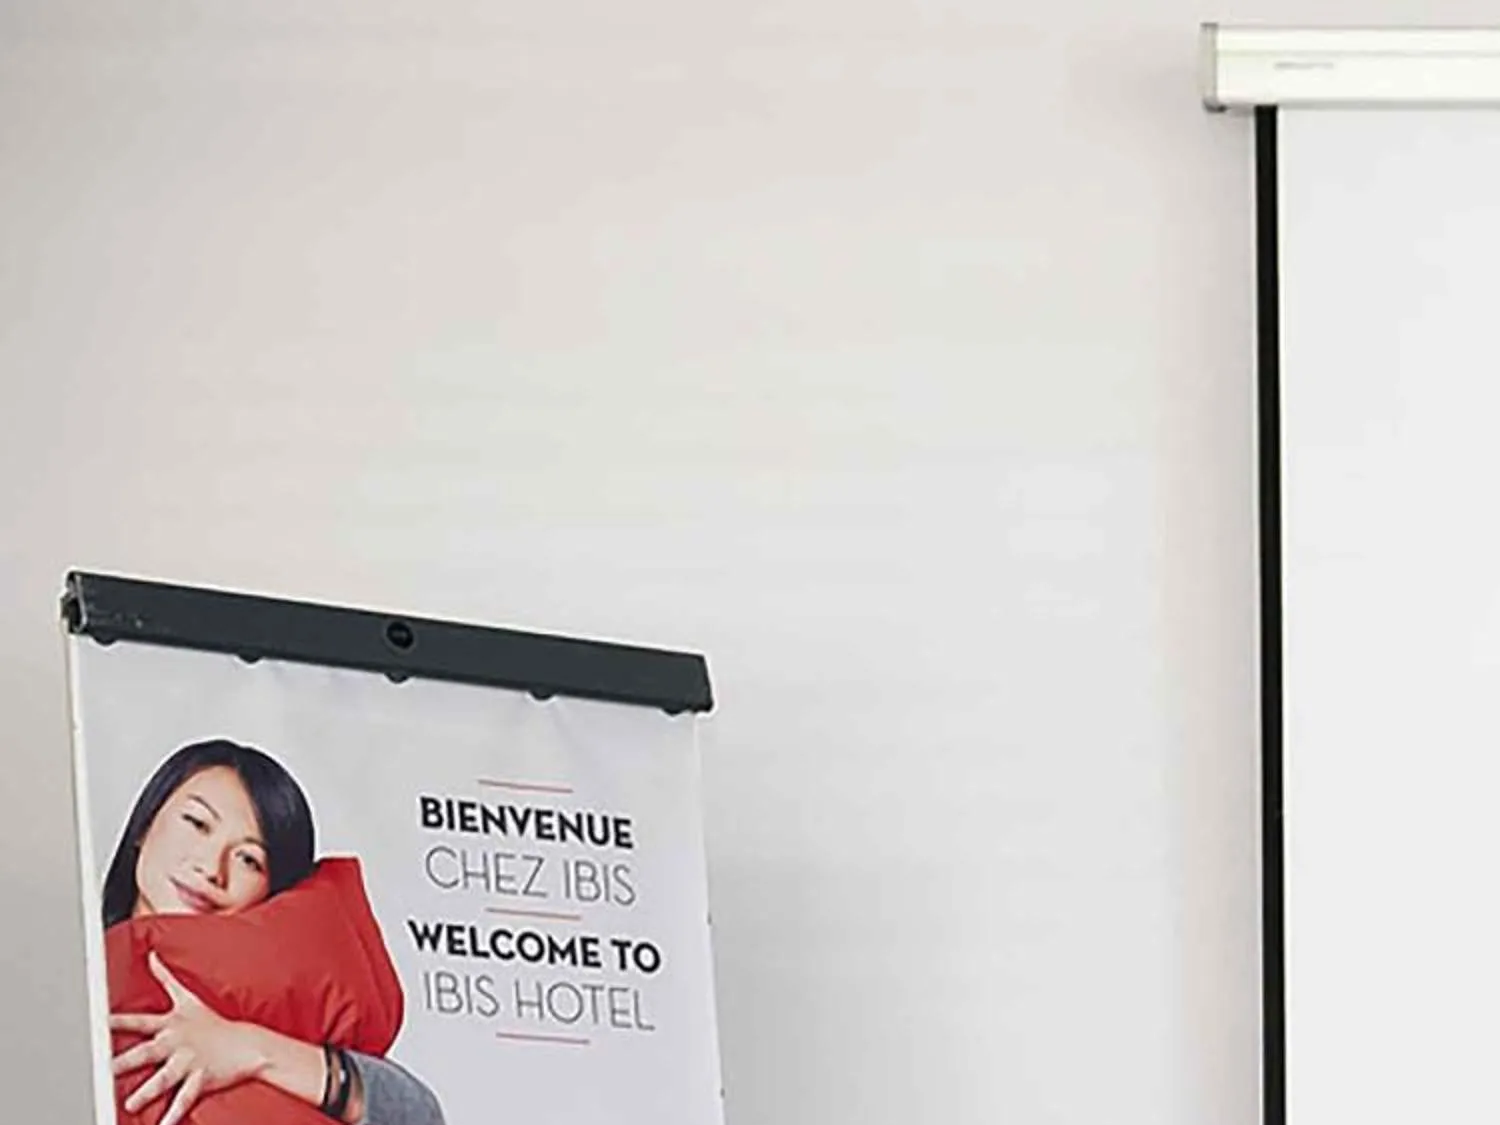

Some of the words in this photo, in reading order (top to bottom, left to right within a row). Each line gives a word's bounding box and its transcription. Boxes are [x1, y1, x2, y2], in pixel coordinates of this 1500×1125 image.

[419, 796, 635, 849] BIENVENUE
[425, 845, 548, 898] CHEZ
[563, 859, 637, 906] IBIS
[406, 920, 602, 968] WELCOME
[611, 938, 662, 973] TO
[424, 971, 499, 1018] IBIS
[515, 979, 656, 1032] HOTEL
